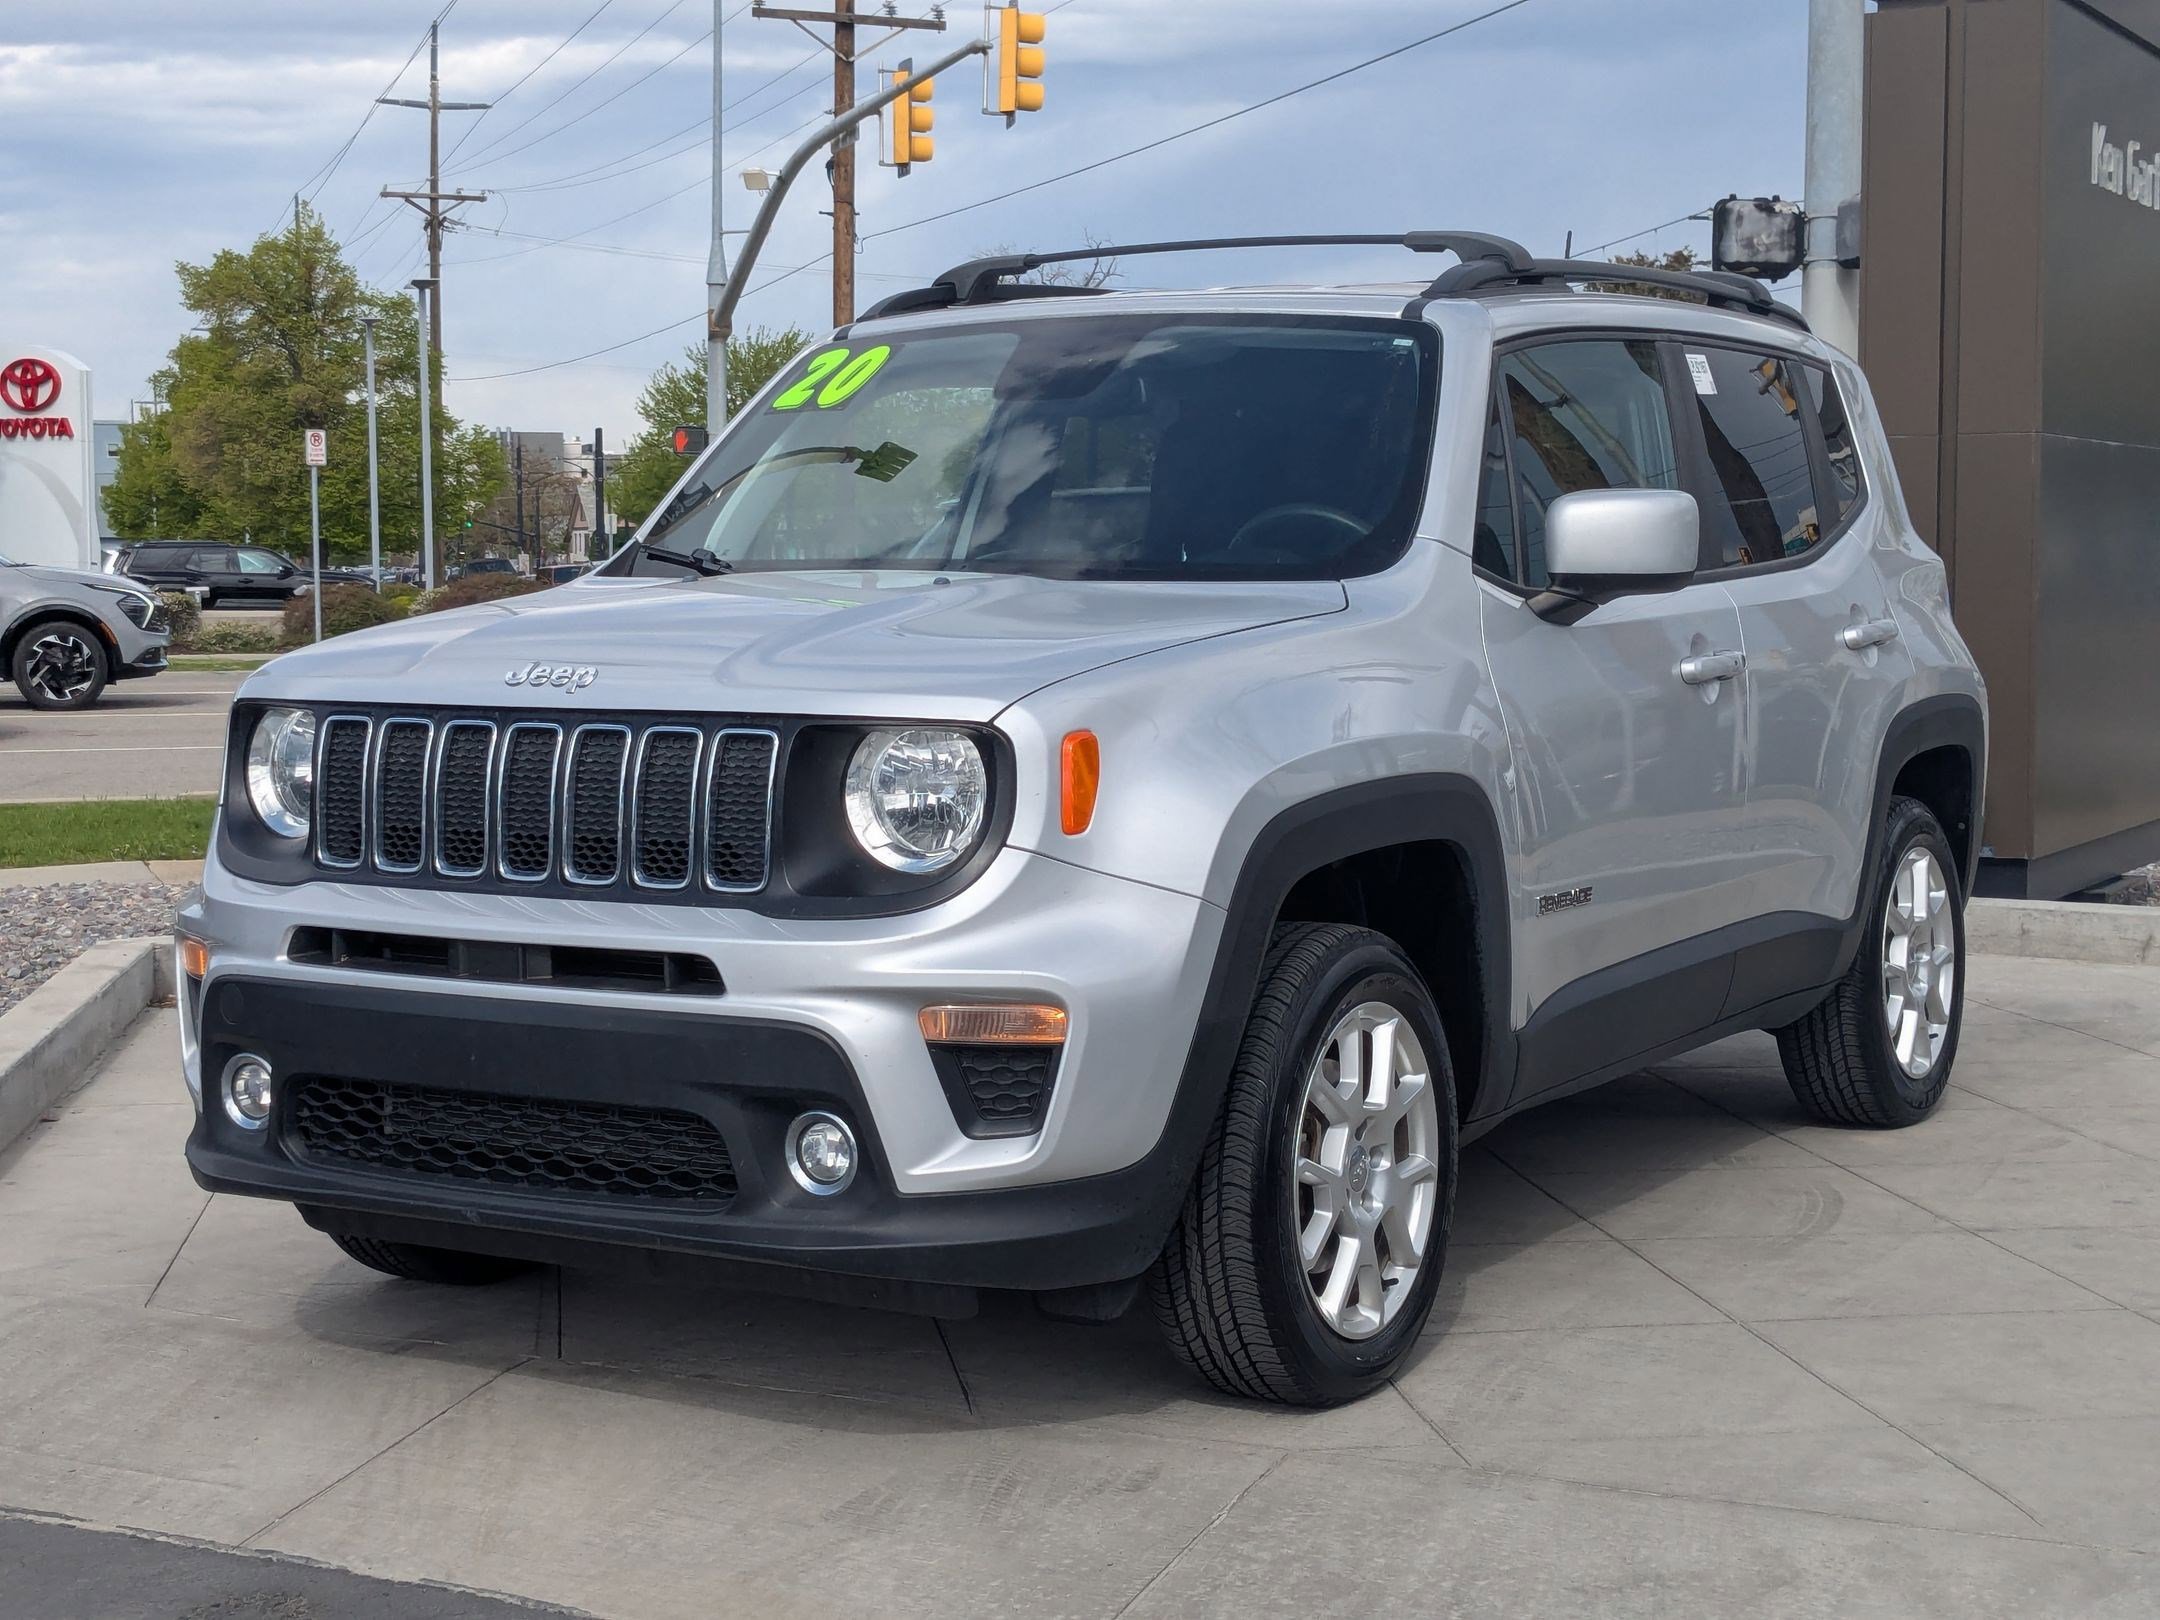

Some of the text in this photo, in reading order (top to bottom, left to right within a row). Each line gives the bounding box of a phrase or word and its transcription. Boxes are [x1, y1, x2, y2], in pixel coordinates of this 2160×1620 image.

[772, 345, 891, 410] 20
[0, 417, 75, 440] OYOTA
[504, 660, 599, 694] Jeep
